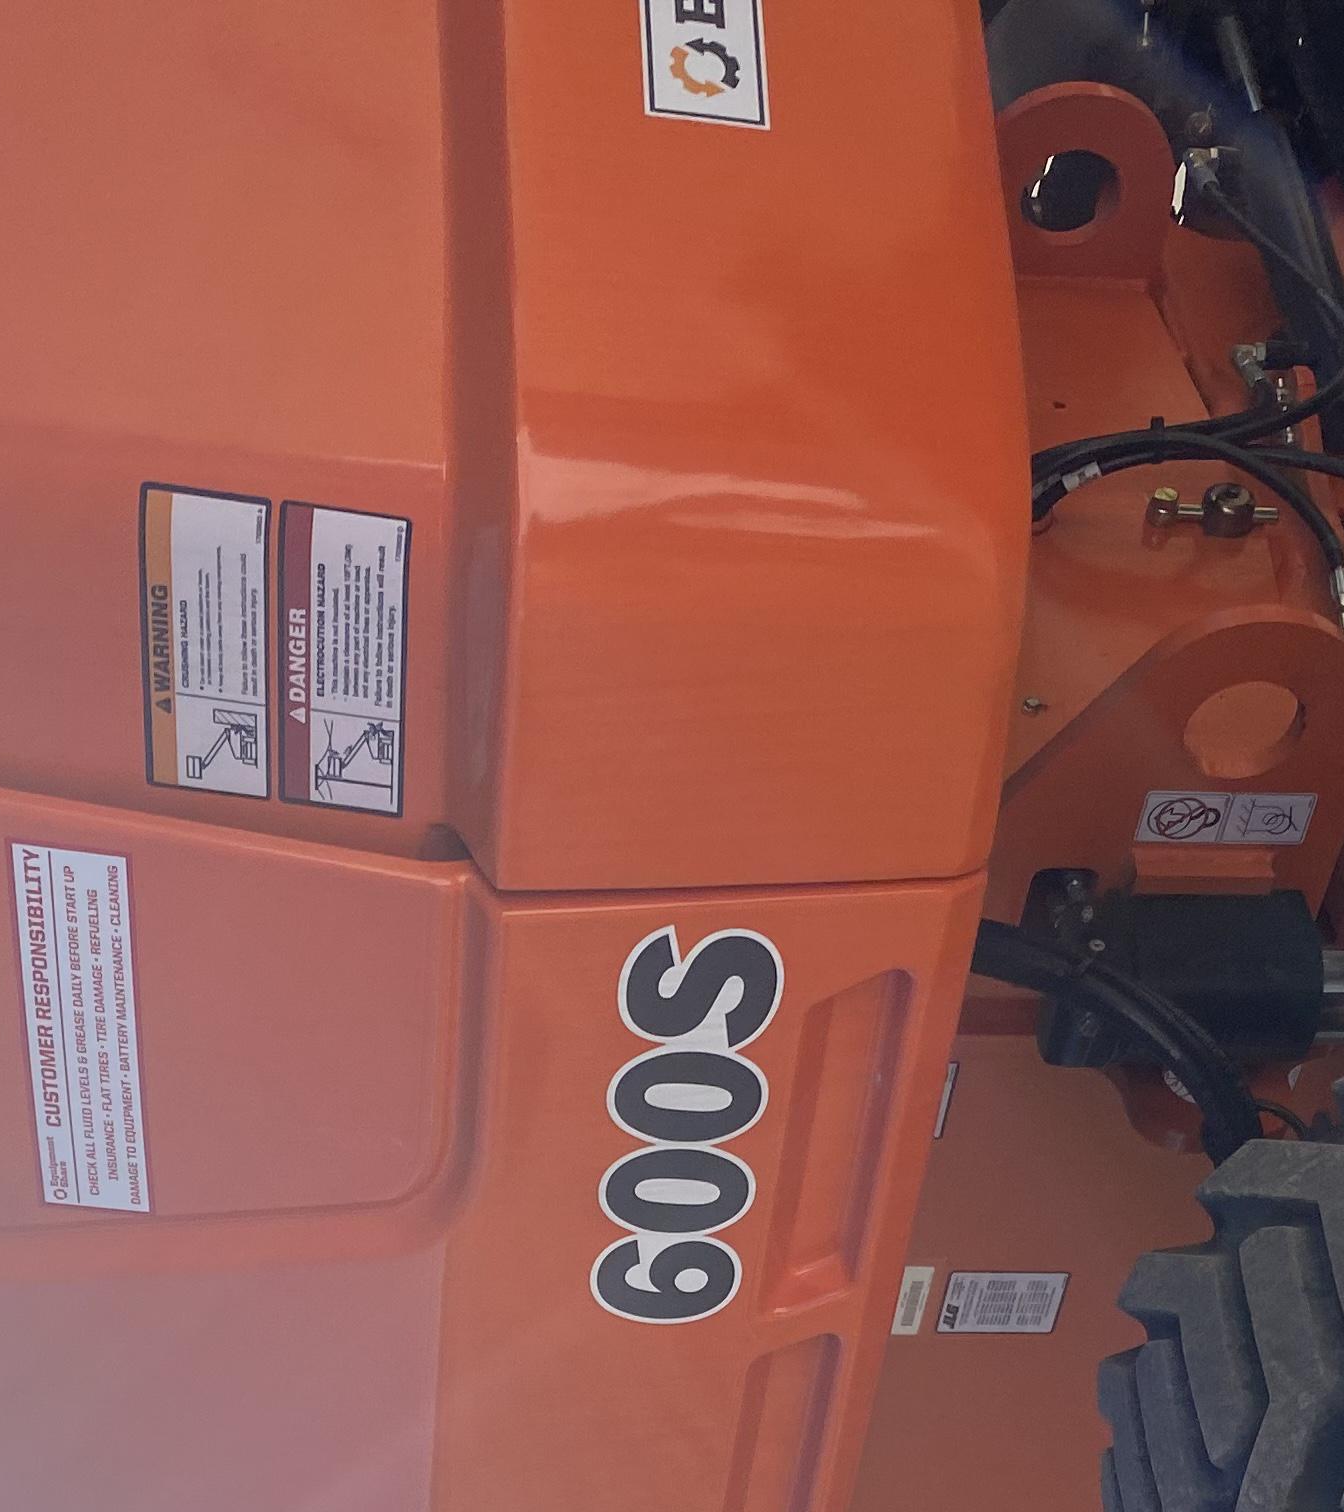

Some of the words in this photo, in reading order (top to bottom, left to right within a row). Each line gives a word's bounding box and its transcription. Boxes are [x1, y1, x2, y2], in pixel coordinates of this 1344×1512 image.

[316, 562, 326, 608] HAZARD
[150, 584, 171, 693] WARNING
[179, 599, 189, 639] HAZARD
[180, 640, 190, 689] CRUSHING
[288, 608, 307, 704] DANGER
[316, 609, 326, 698] ELECTROCUTION
[63, 865, 75, 883] UP
[107, 864, 121, 927] CLEANING
[64, 885, 78, 924] START
[86, 888, 102, 955] REFUELING
[22, 848, 52, 1021] RESPONSIBILITY
[67, 926, 81, 972] BEFORE
[70, 973, 84, 1008] DAILY
[91, 964, 106, 1013] DAMAGE
[111, 935, 127, 1021] MAINTENANCE
[74, 1010, 87, 1054] GREASE
[94, 1016, 108, 1043] TIRE
[116, 1021, 131, 1072] BATTERY
[37, 1025, 62, 1128] CUSTOMER
[78, 1056, 88, 1065] &
[97, 1051, 111, 1084] TIRES
[77, 1066, 92, 1105] LEVELS
[100, 1086, 113, 1112] FLAT
[81, 1108, 95, 1140] FLUID
[120, 1079, 137, 1144] EQUIPMENT
[590, 926, 783, 1322] 600S
[85, 1142, 98, 1160] ALL
[103, 1119, 119, 1181] INSURANCE
[125, 1145, 137, 1160] TO
[59, 1161, 69, 1188] Share
[87, 1158, 100, 1196] CHECK
[127, 1162, 142, 1205] DAMAGE
